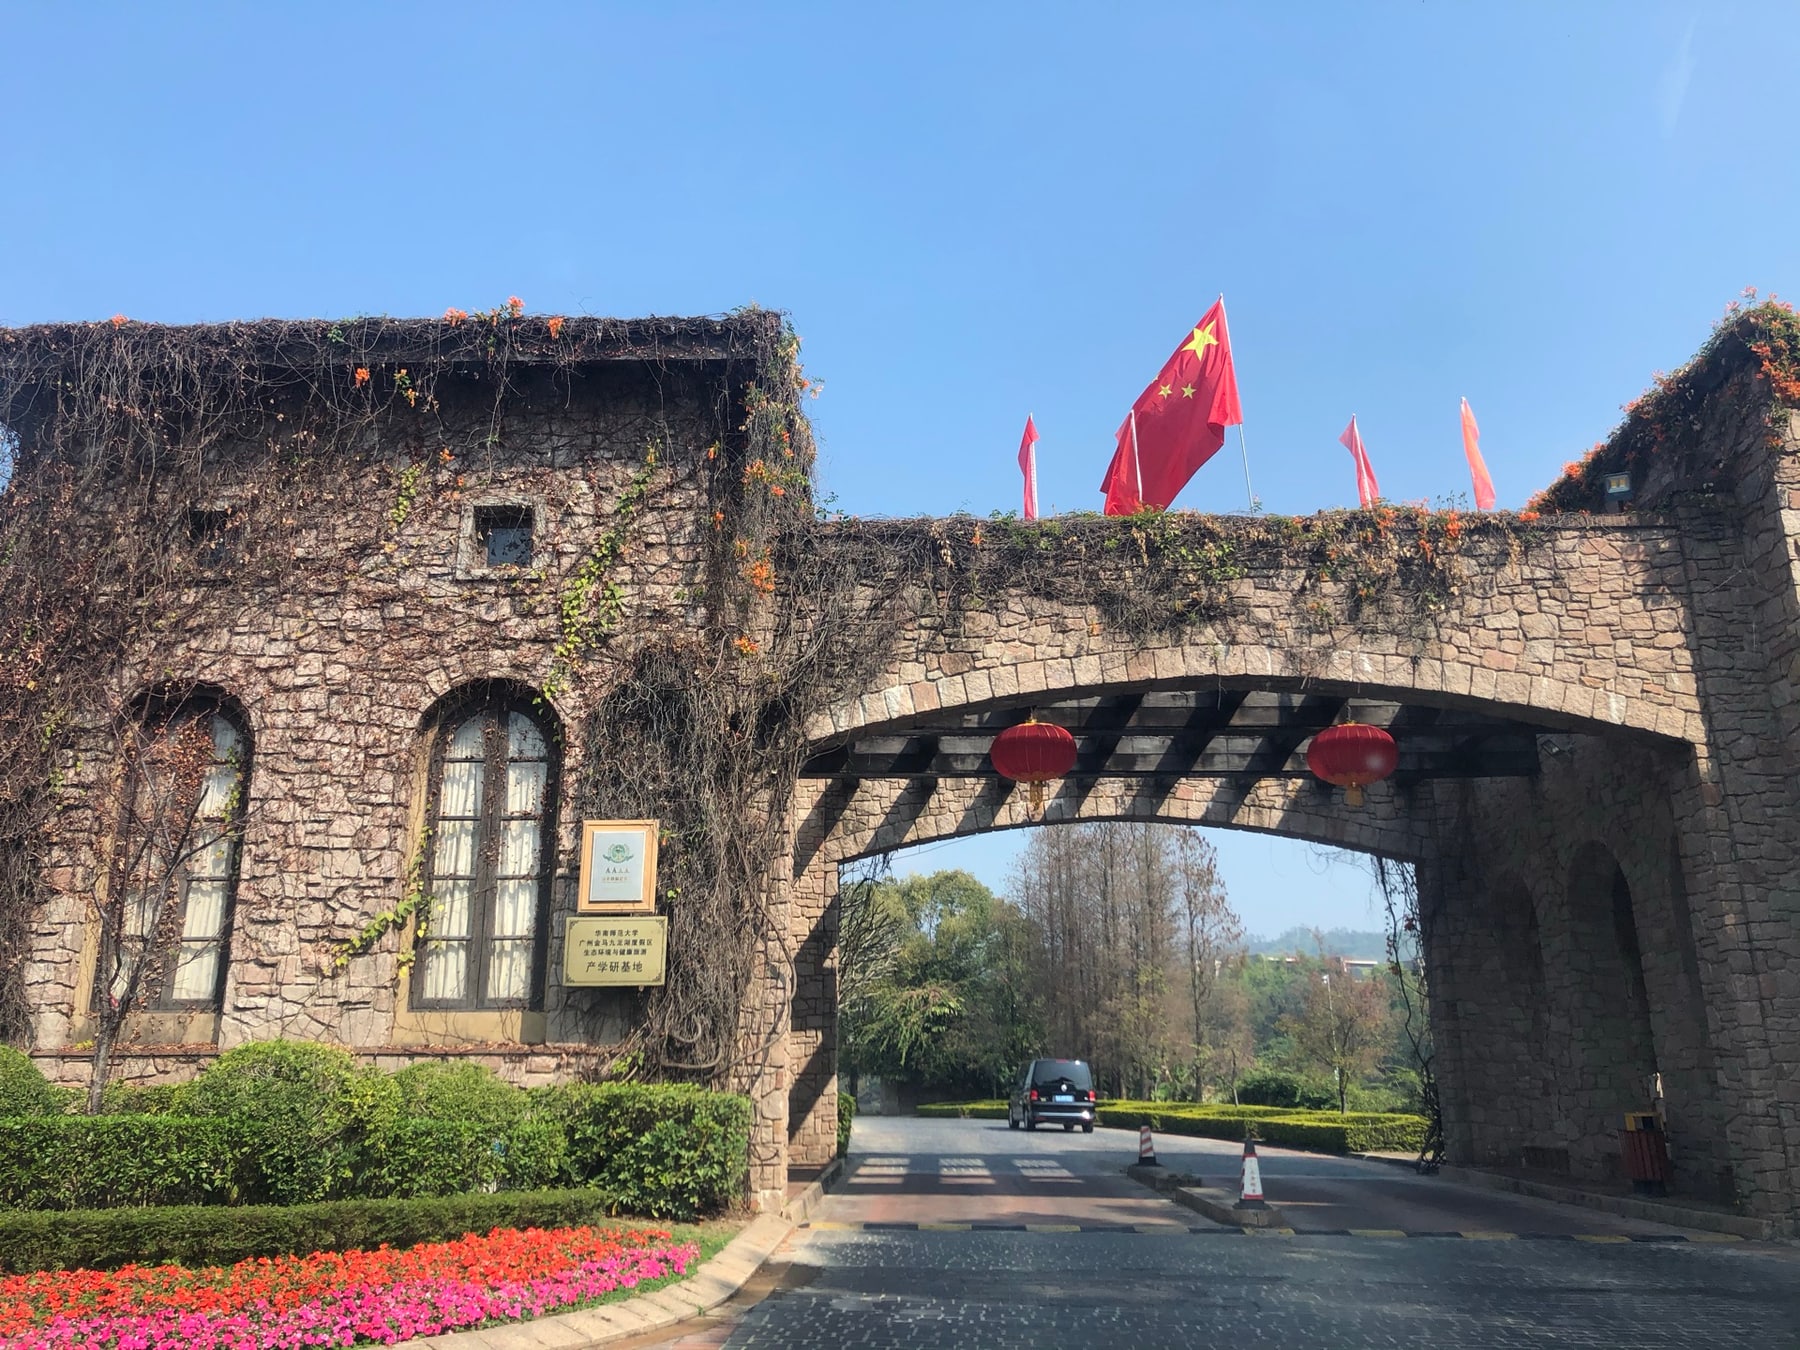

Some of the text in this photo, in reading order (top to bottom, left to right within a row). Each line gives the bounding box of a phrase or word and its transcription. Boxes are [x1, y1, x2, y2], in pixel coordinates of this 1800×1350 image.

[595, 929, 639, 937] 华南师范大学
[586, 961, 643, 973] 产学研基地
